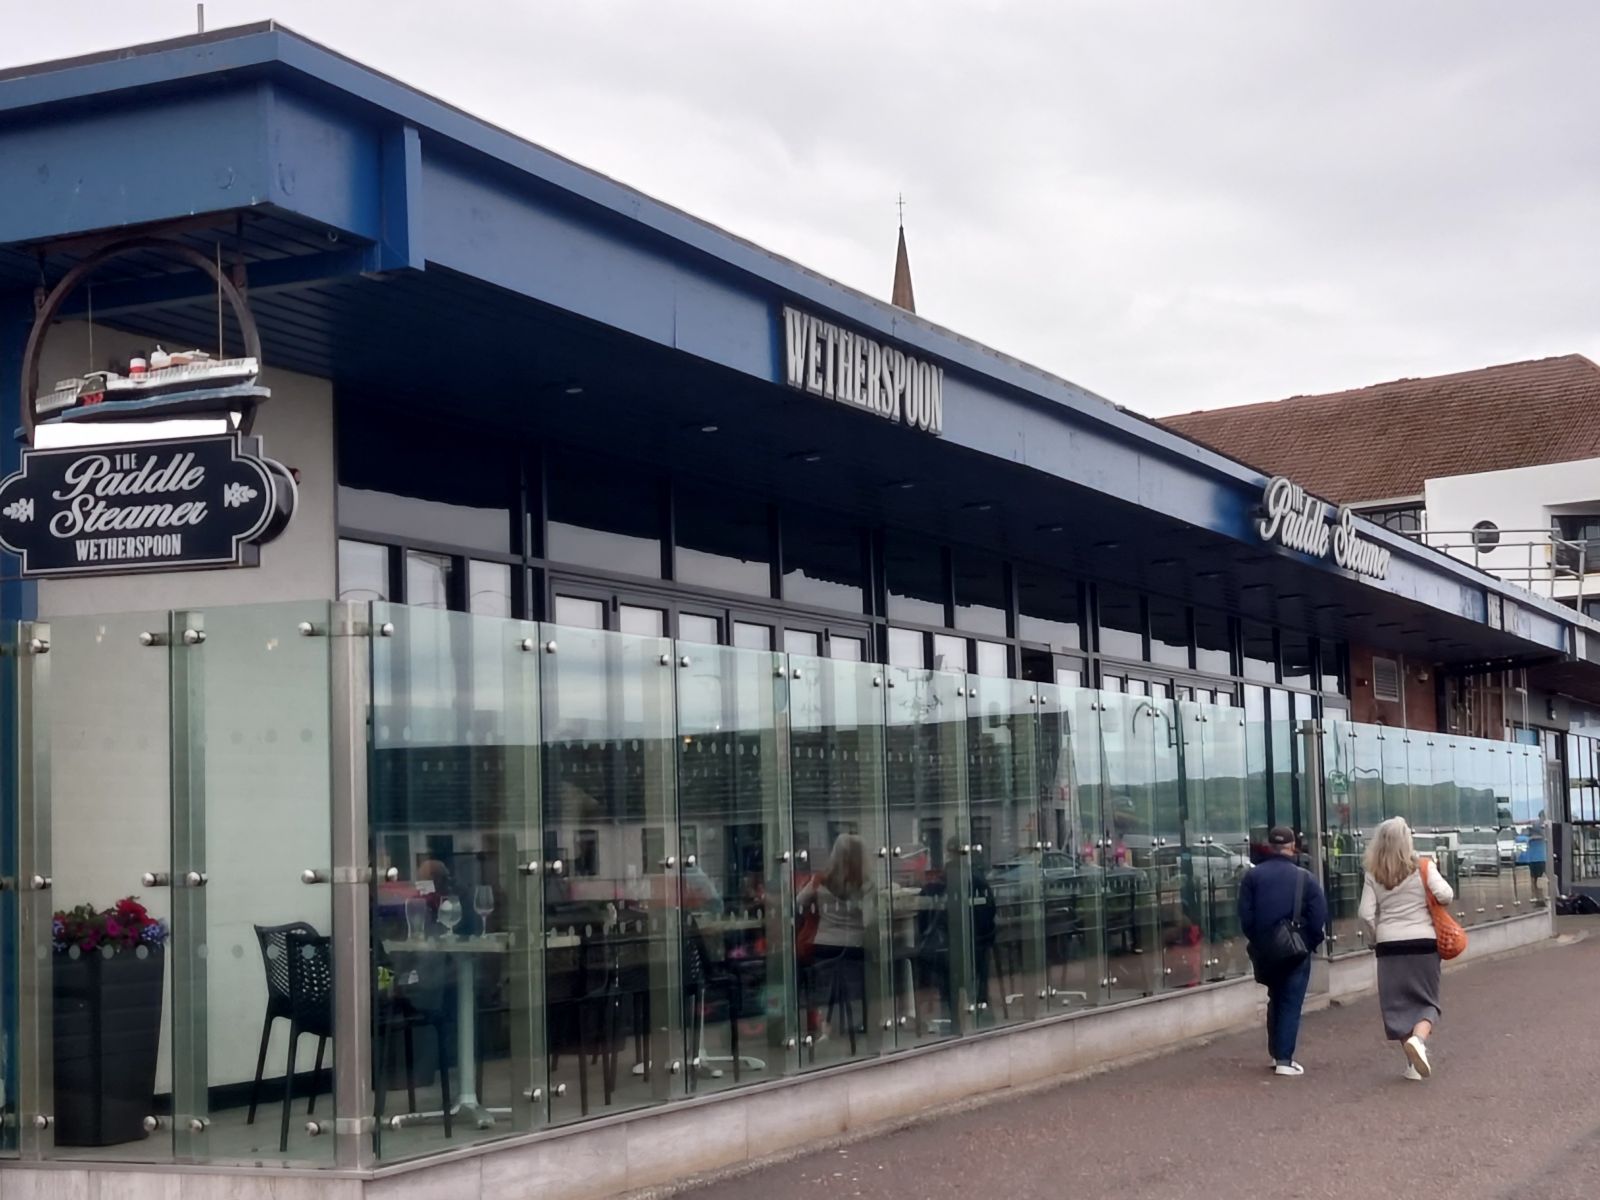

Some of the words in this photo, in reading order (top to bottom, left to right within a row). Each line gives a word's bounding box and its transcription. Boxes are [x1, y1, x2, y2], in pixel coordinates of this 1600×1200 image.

[783, 306, 943, 434] WETHERSPOON
[52, 452, 205, 500] Paddle
[114, 453, 137, 470] THE
[50, 494, 208, 538] Steamer
[1260, 476, 1330, 558] Paddle
[1331, 505, 1391, 580] Steamer
[76, 534, 182, 561] WETHERSPOON
